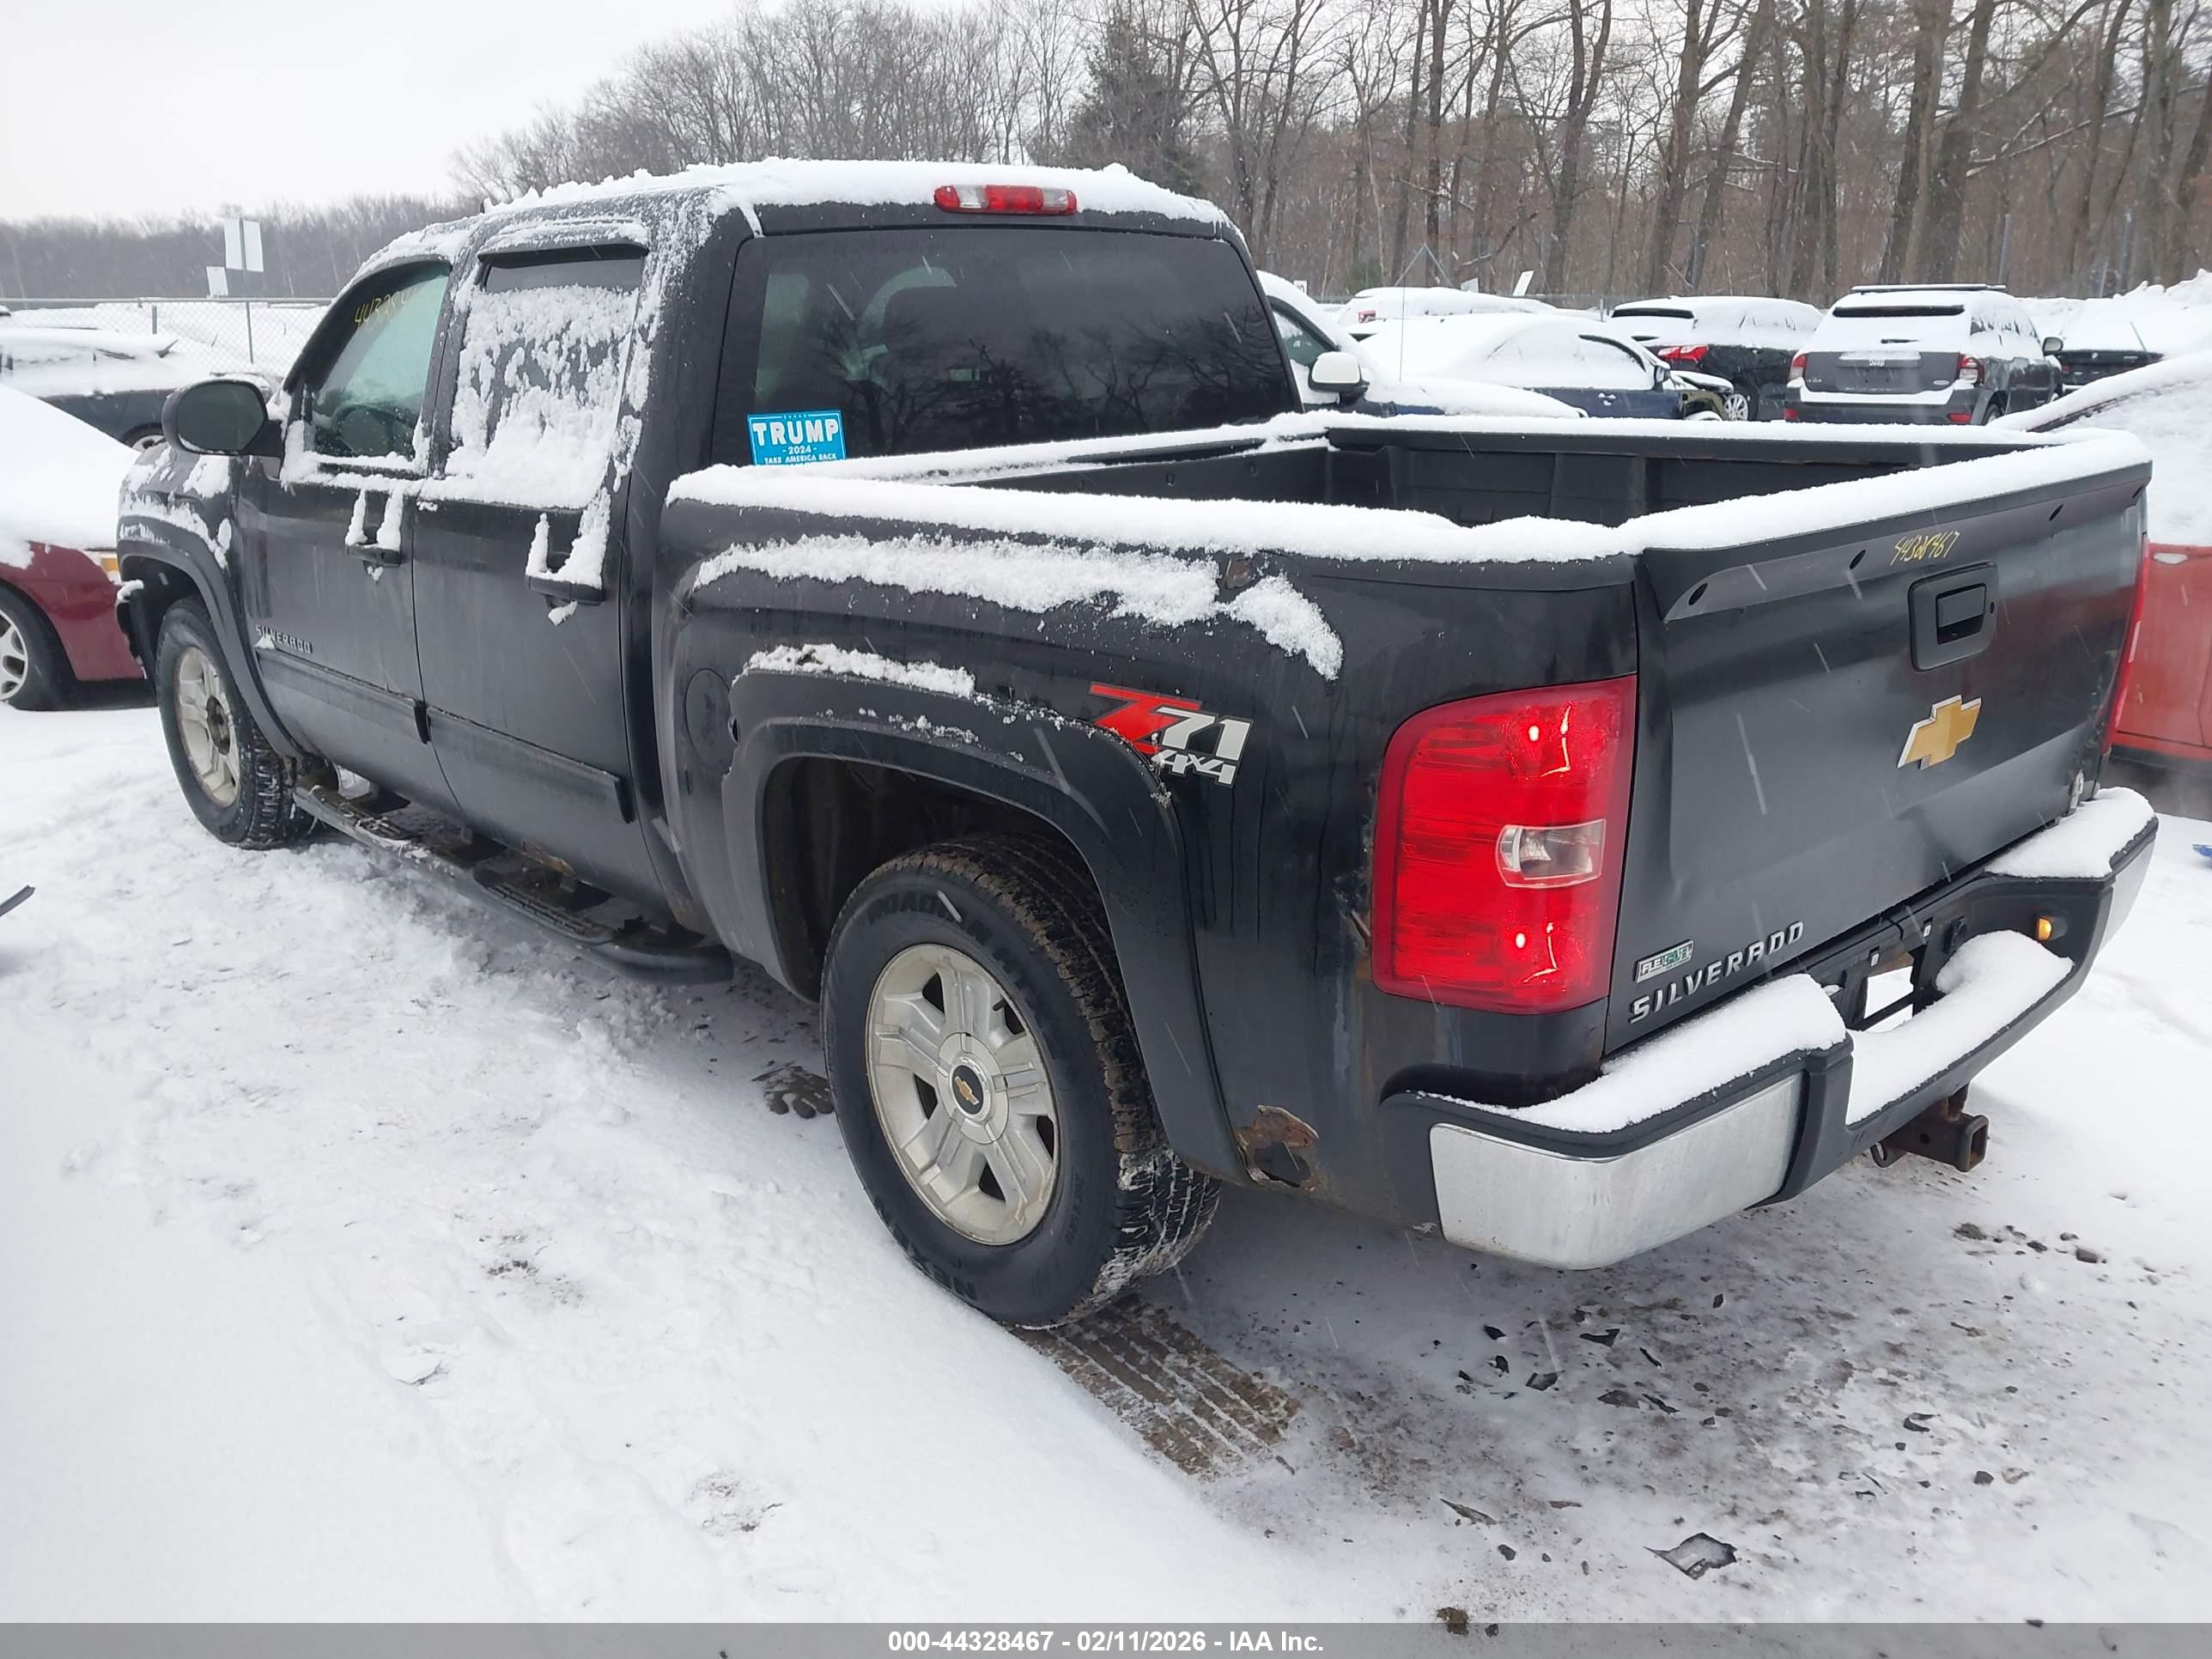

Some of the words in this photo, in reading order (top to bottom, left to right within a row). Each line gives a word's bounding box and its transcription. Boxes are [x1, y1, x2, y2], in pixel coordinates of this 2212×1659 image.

[752, 419, 839, 447] TRUMP
[763, 456, 782, 465] TAKE
[785, 453, 817, 463] AMERICA
[818, 453, 837, 461] BACK
[787, 445, 811, 455] 2024
[1091, 684, 1251, 761] Z71
[1630, 921, 1804, 1024] SILVERADO
